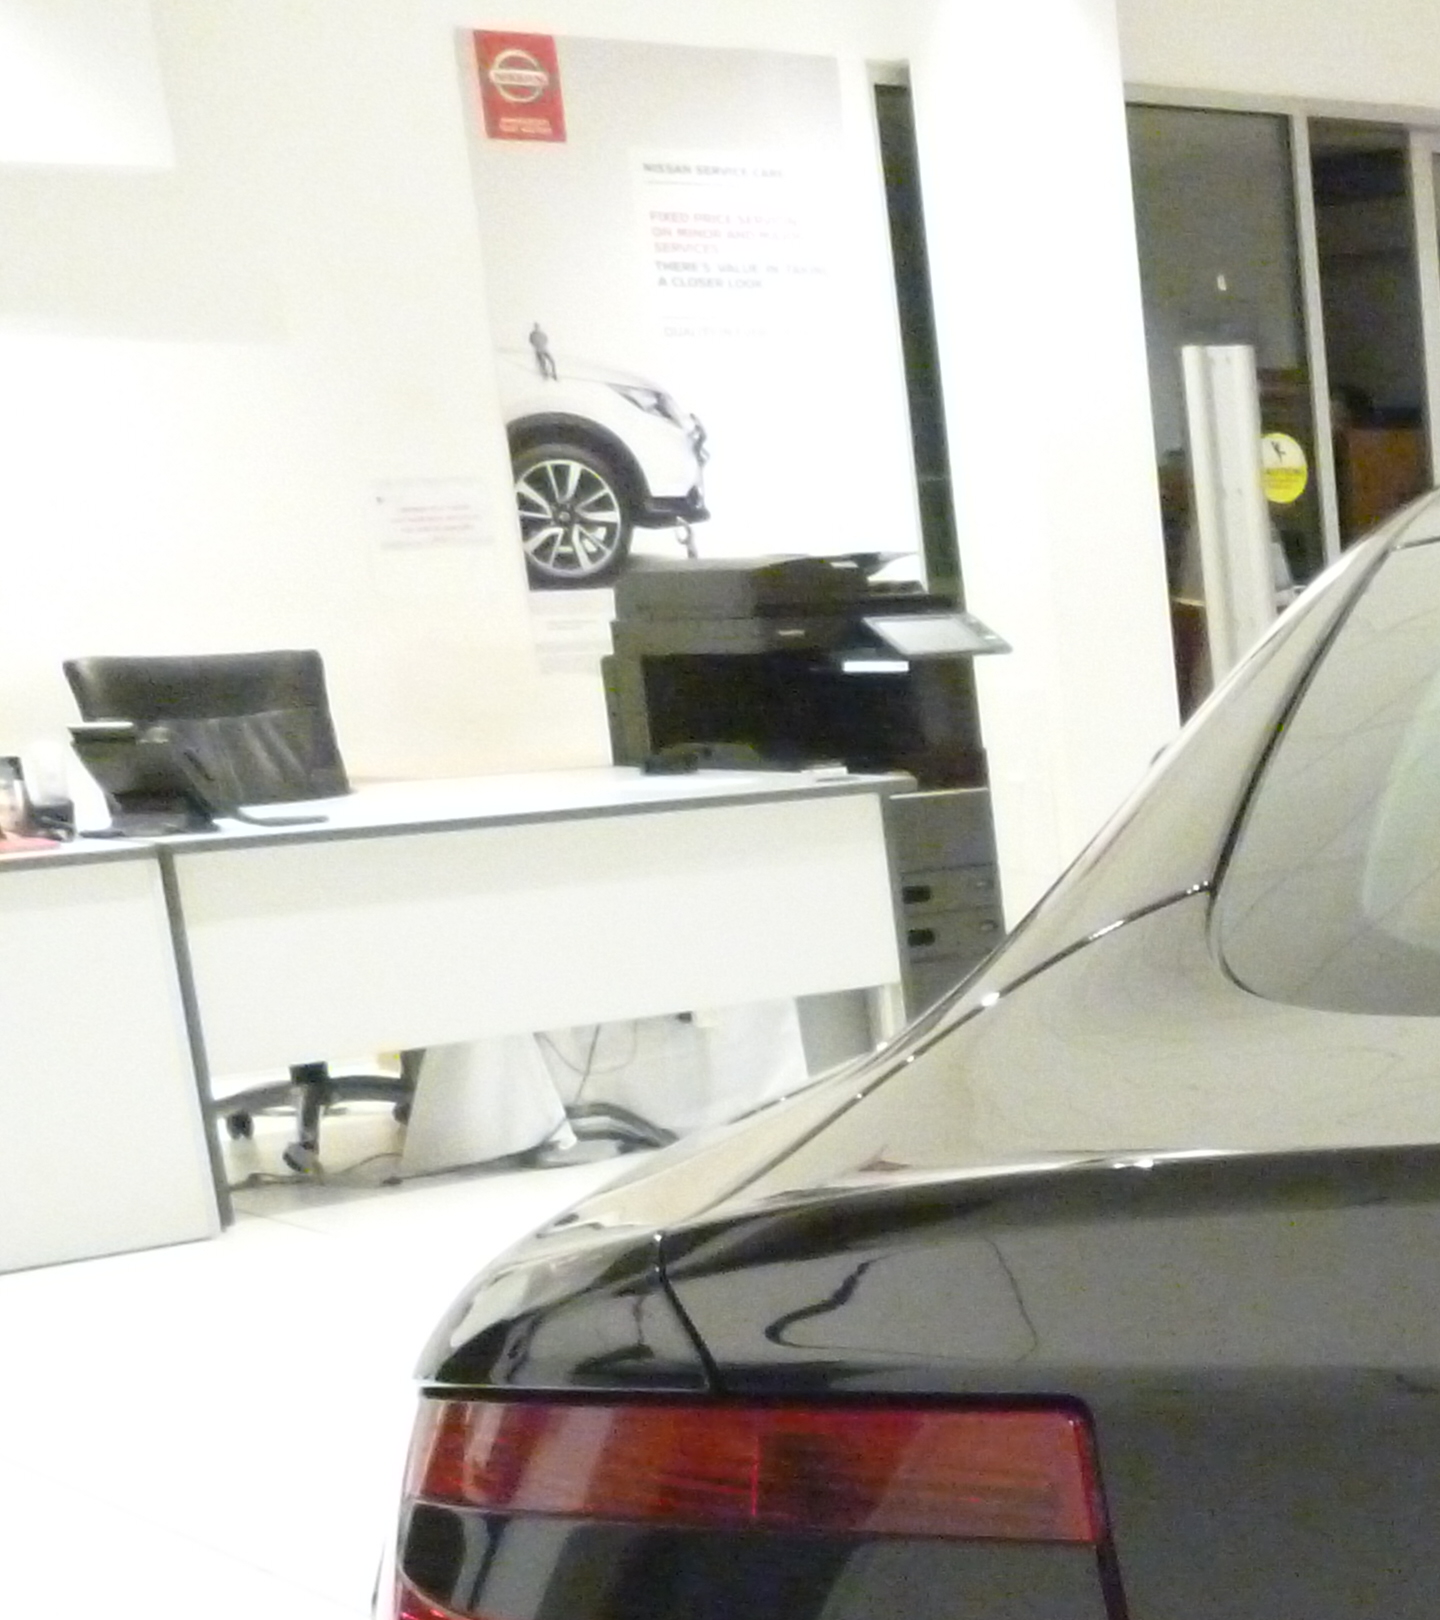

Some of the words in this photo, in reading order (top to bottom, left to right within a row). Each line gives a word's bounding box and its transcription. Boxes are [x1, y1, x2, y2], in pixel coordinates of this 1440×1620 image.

[642, 163, 691, 175] NISSAN
[694, 165, 746, 176] SERVICE
[649, 210, 689, 224] FIXED
[692, 213, 730, 225] PRICE
[651, 227, 671, 238] ON
[675, 228, 721, 240] MINOR
[725, 230, 755, 241] AND
[653, 242, 719, 255] SERVICES
[716, 262, 757, 274] VALUE
[657, 276, 668, 288] A
[670, 277, 722, 289] CLOSER
[726, 279, 763, 290] LOOK
